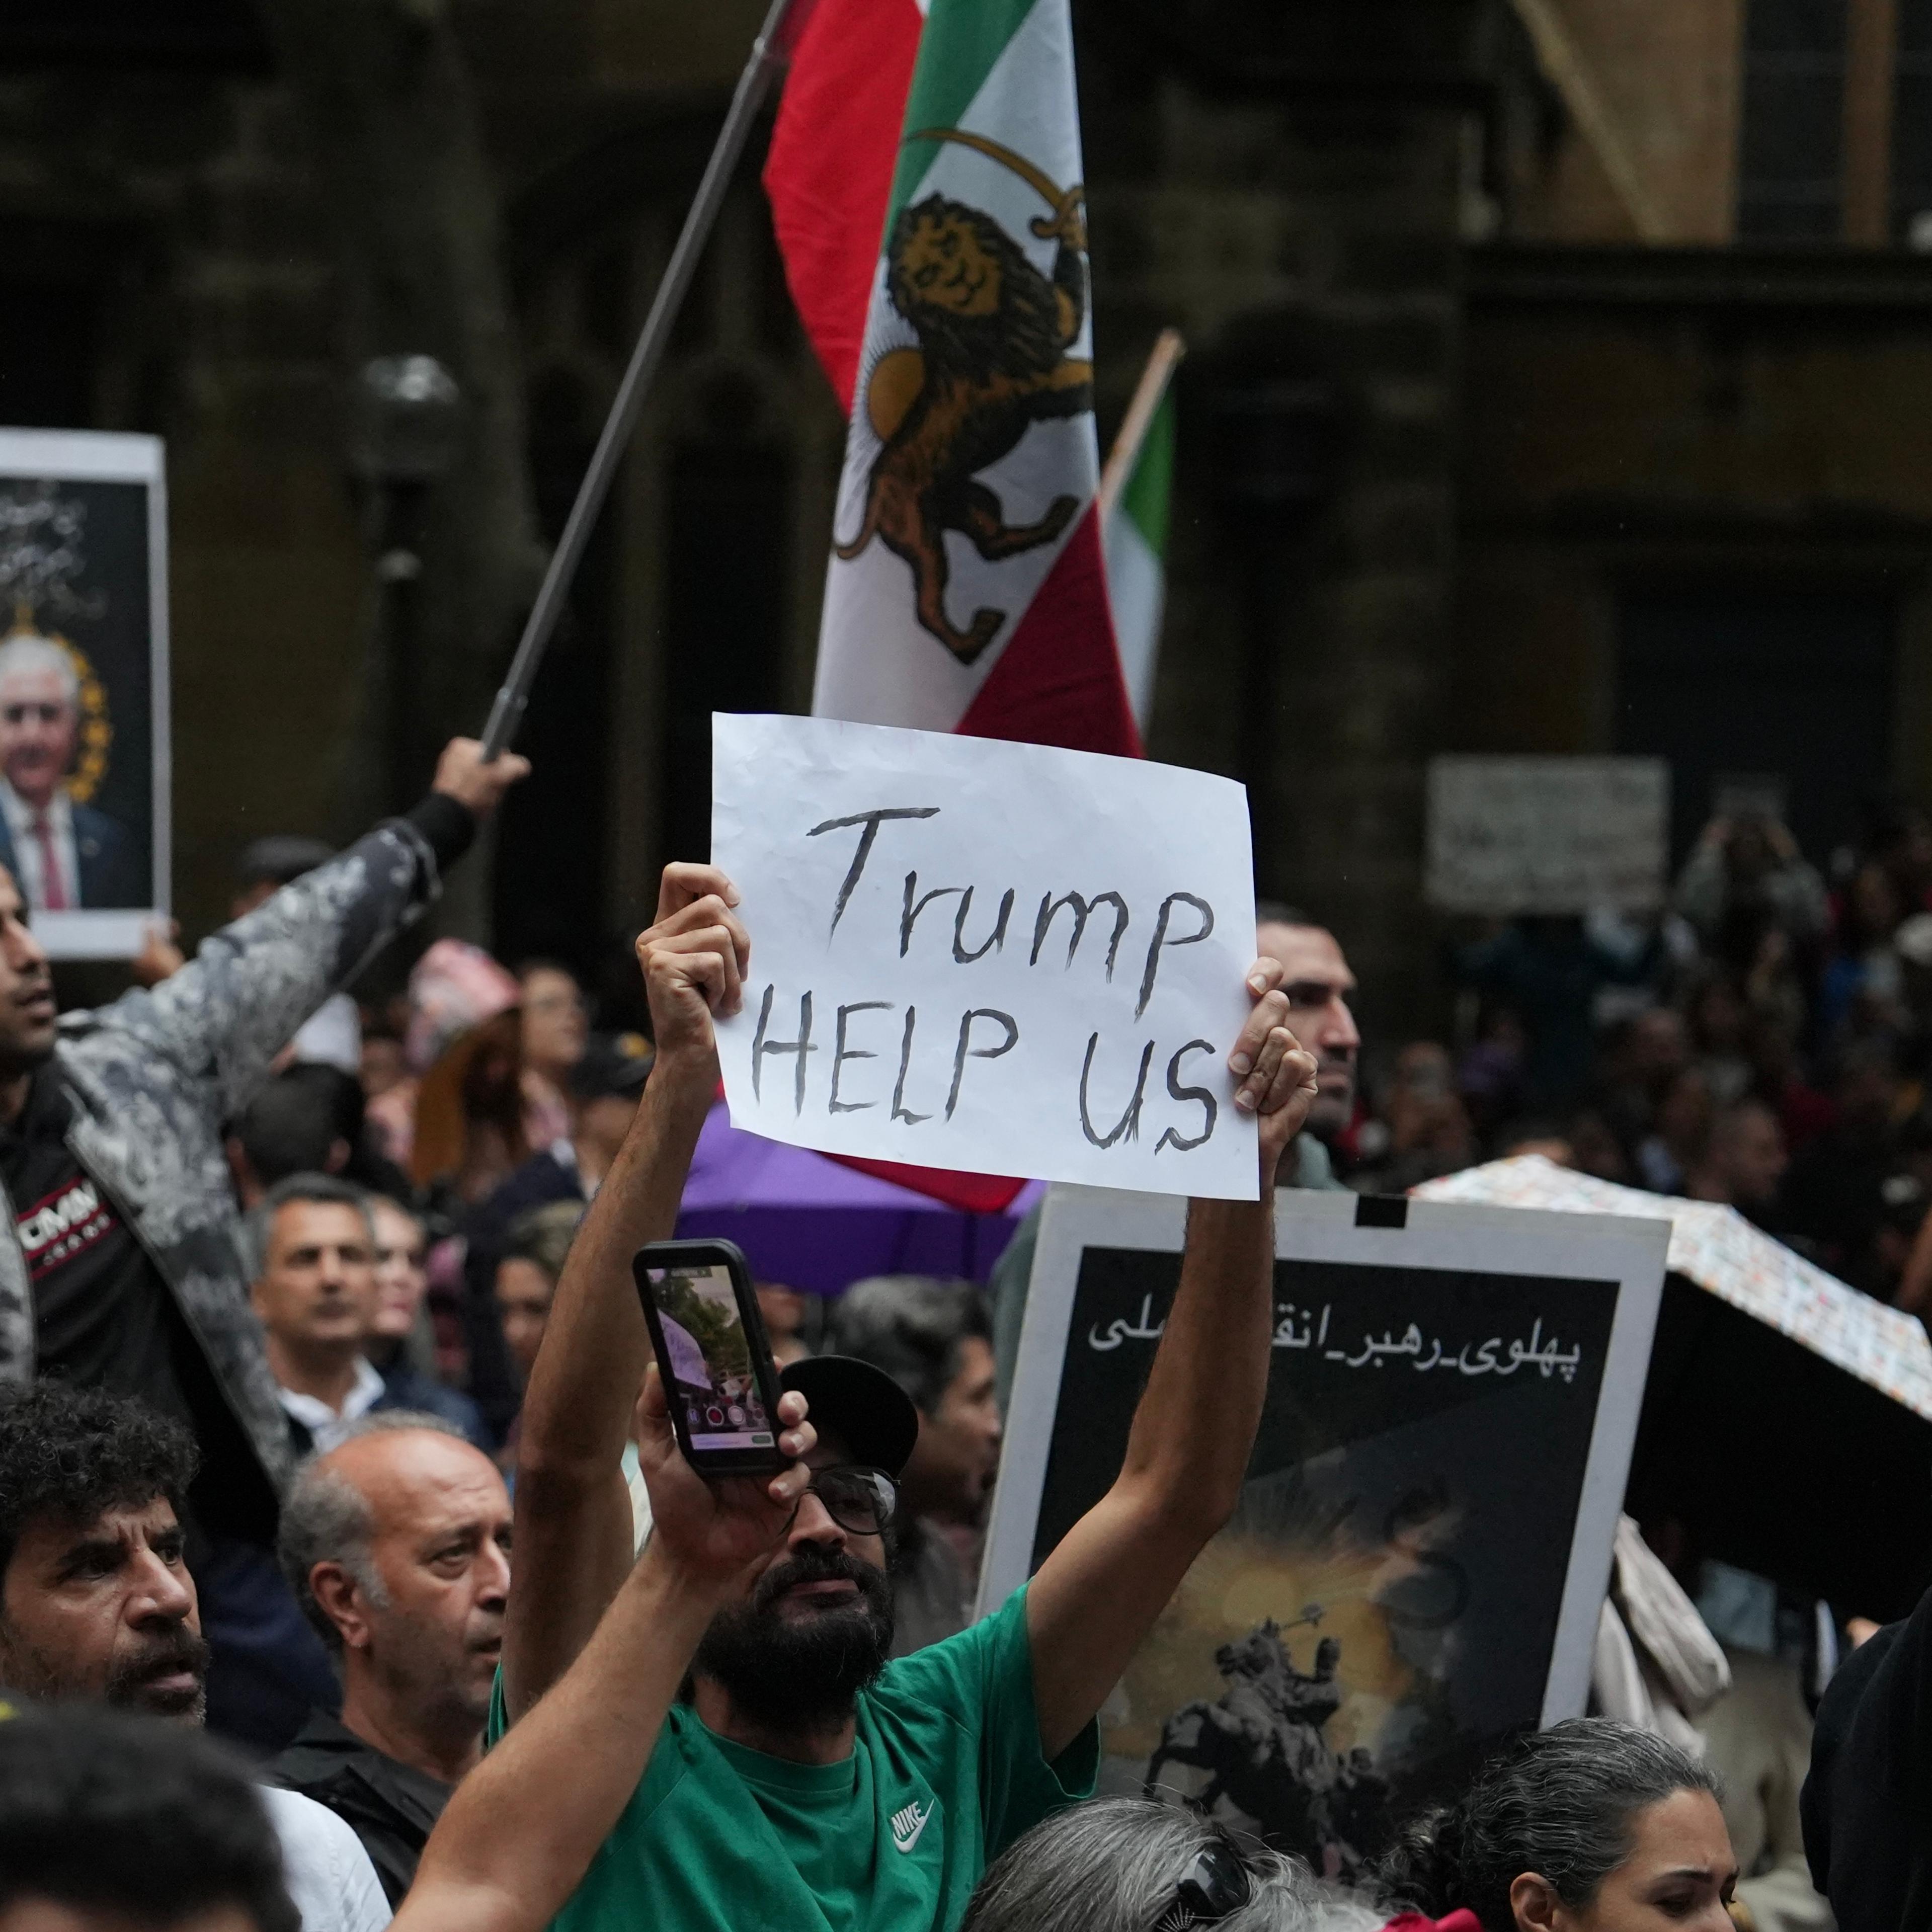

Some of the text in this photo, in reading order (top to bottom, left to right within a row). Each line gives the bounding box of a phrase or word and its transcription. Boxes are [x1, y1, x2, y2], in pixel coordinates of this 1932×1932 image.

[806, 807, 1215, 1023] Trump
[752, 984, 1218, 1156] HELP US
[891, 1800, 926, 1839] NIKE
